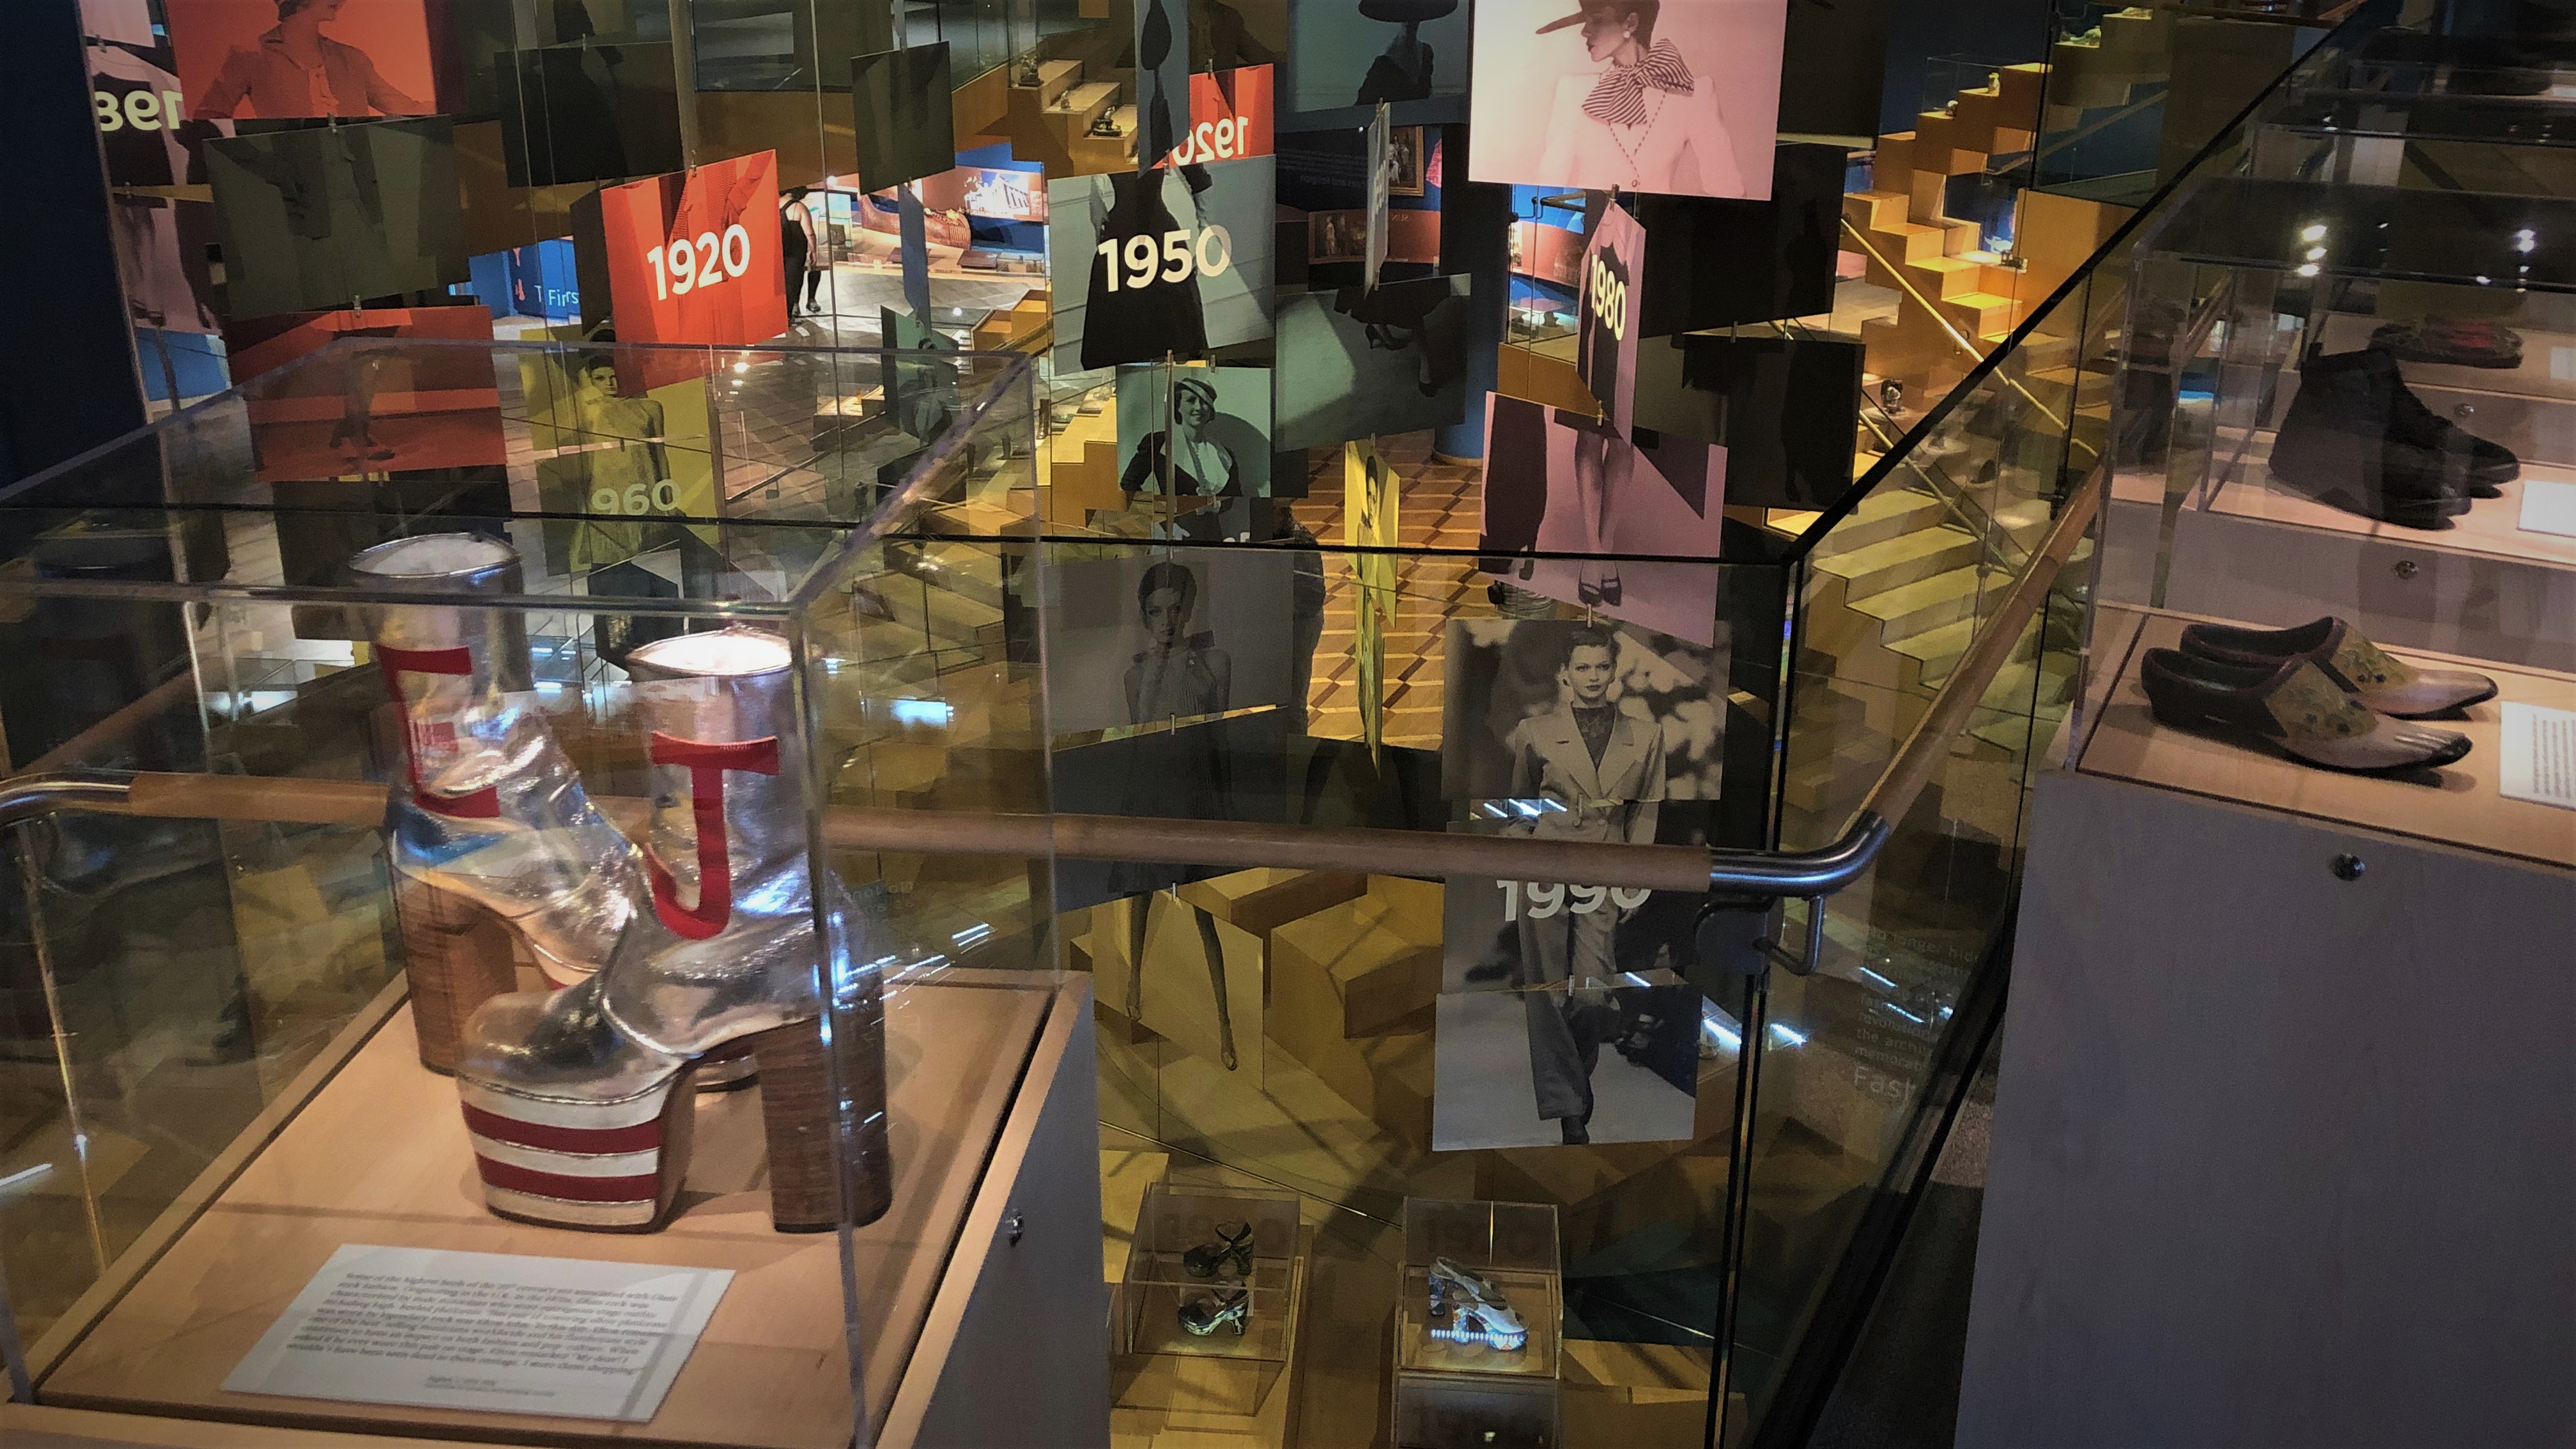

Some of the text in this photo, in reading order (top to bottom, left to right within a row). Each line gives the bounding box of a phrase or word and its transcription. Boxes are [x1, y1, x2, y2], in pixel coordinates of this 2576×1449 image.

[647, 224, 751, 301] 1920
[1097, 224, 1233, 293] 1950
[1591, 254, 1626, 341] 1980
[644, 730, 780, 940] J
[1856, 1027, 1879, 1043] the
